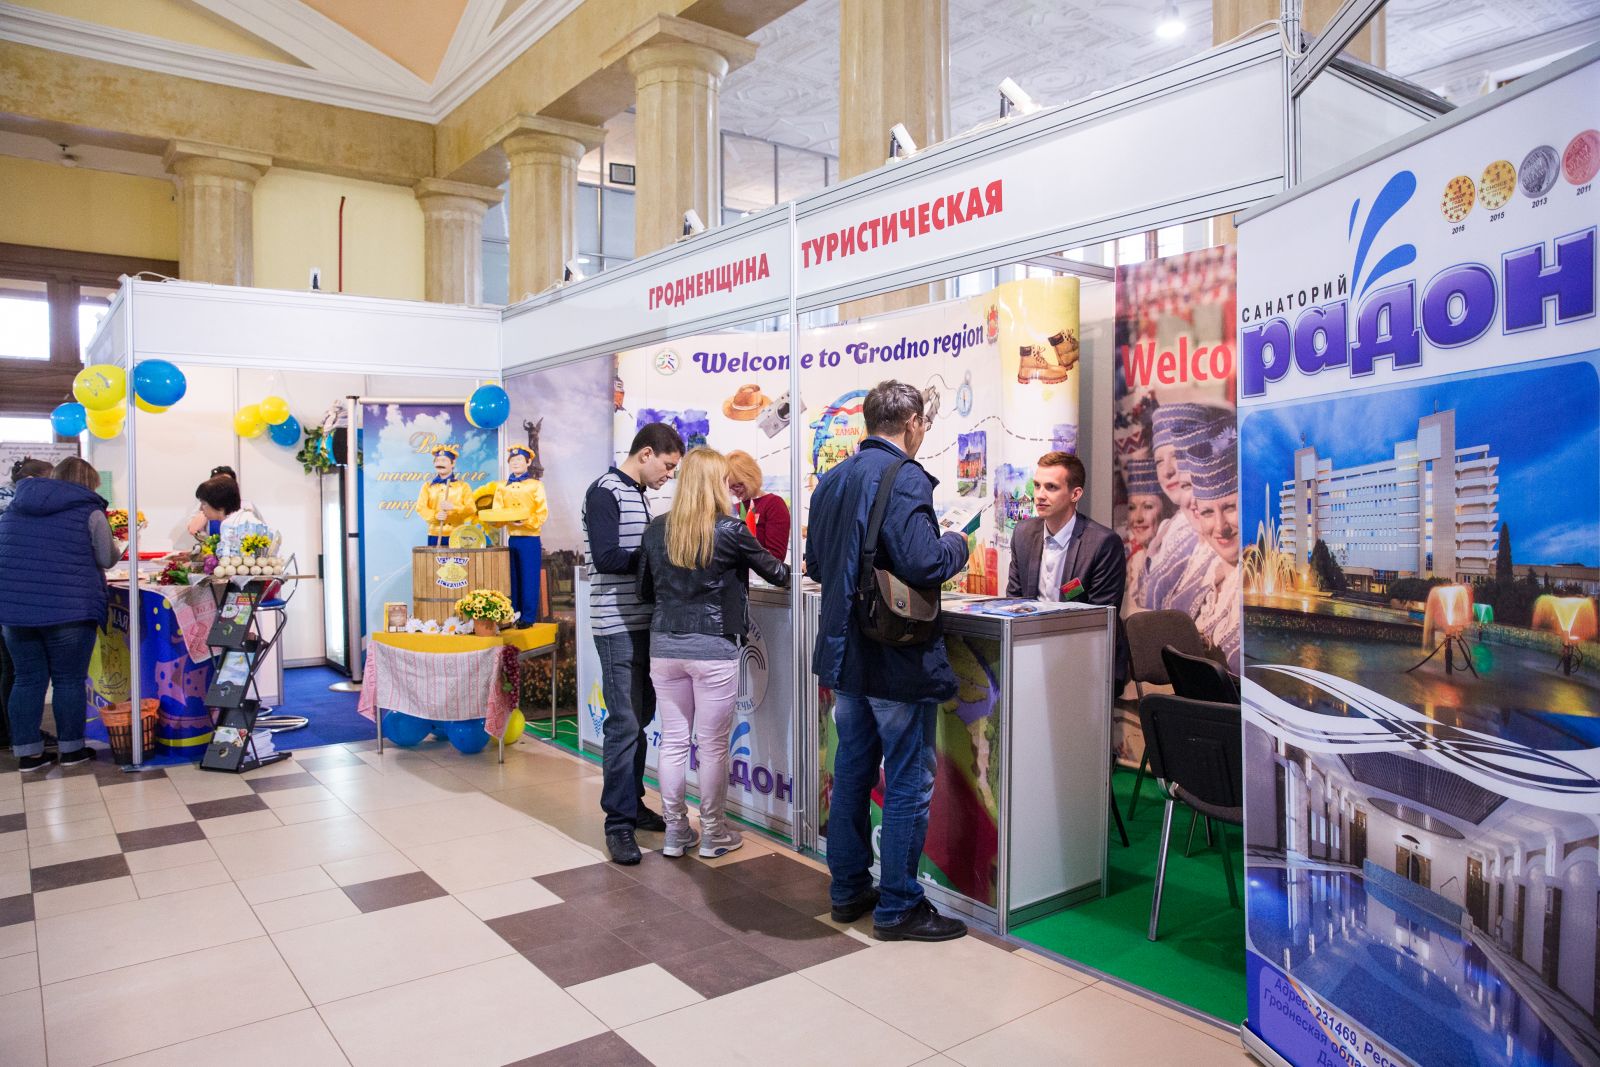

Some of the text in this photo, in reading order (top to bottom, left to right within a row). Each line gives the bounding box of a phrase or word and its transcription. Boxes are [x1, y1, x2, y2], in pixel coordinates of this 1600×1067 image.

[1531, 197, 1548, 209] 2013
[1576, 183, 1592, 196] 2011
[1489, 211, 1505, 222] 2015
[649, 179, 1003, 310] ГРОДНЕНЩИНА ТУРИСТИЧЕСКАЯ
[1241, 273, 1348, 323] САНАТОРИЙ
[1241, 225, 1598, 399] радон
[819, 348, 841, 368] to
[846, 336, 929, 365] Grodno
[933, 323, 984, 358] region
[1121, 336, 1233, 388] Welco
[1274, 978, 1313, 1011] Адрес:
[1315, 1006, 1360, 1052] 231469,
